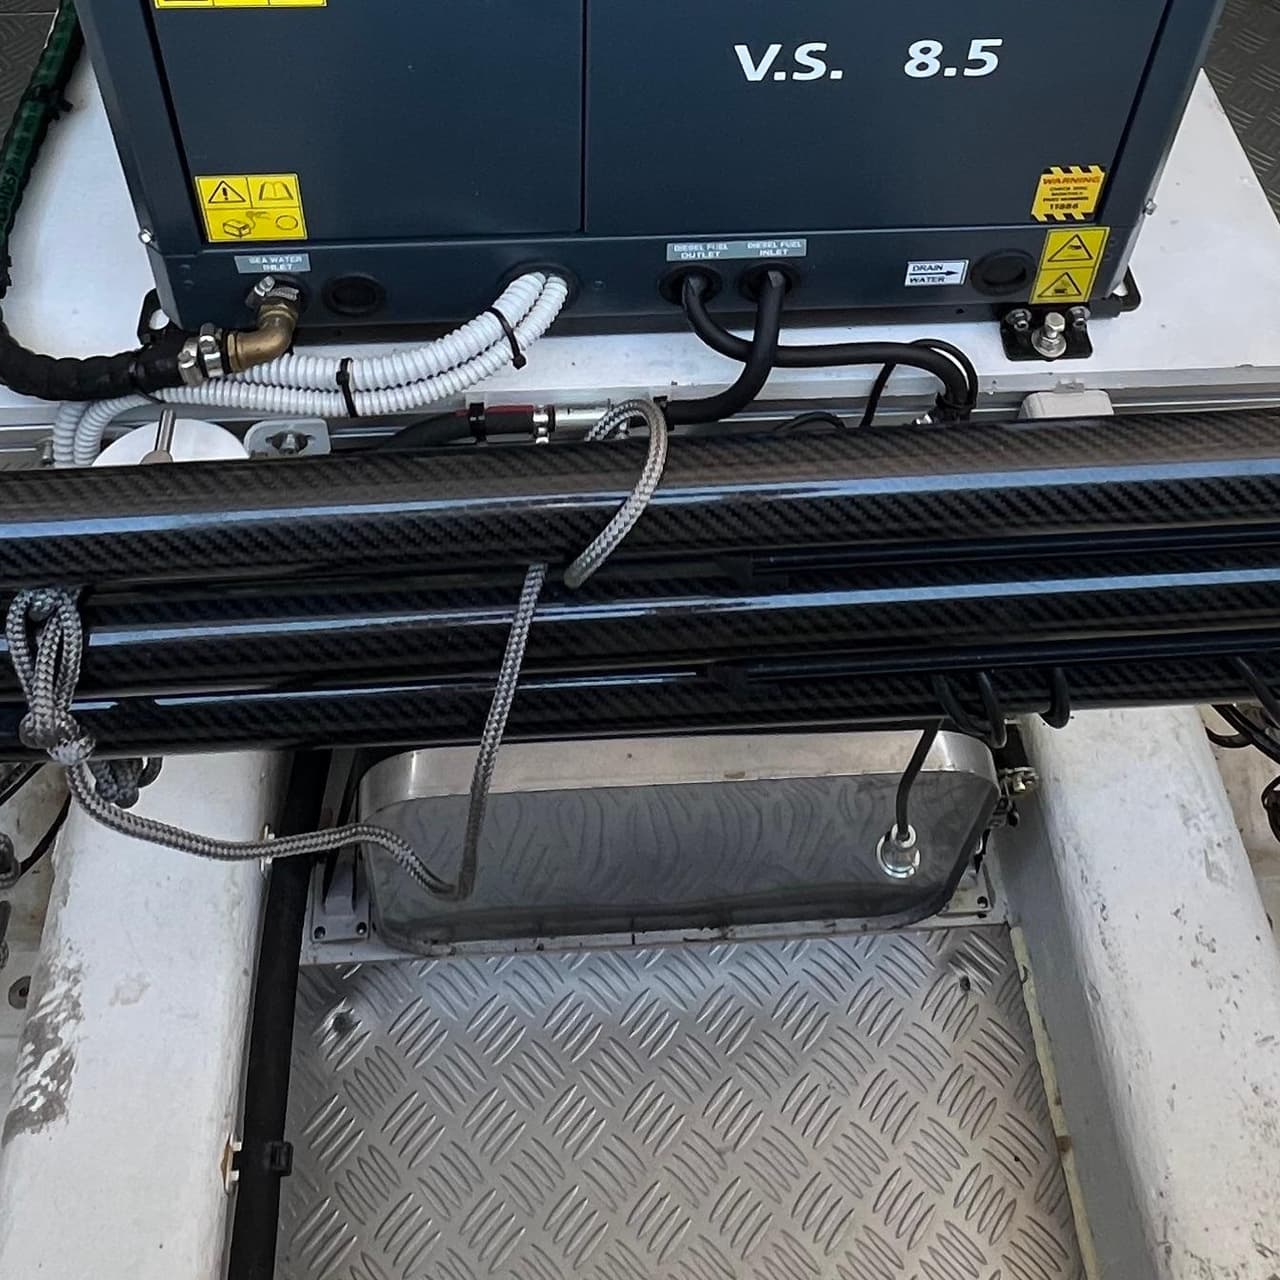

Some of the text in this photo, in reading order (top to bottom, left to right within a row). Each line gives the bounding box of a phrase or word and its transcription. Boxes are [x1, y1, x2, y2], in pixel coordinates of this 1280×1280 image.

[734, 38, 1003, 81] V.S. 8.5
[1043, 175, 1101, 184] WARNING
[680, 251, 720, 259] OUTLET
[760, 248, 789, 256] INLET
[270, 255, 302, 263] WATER
